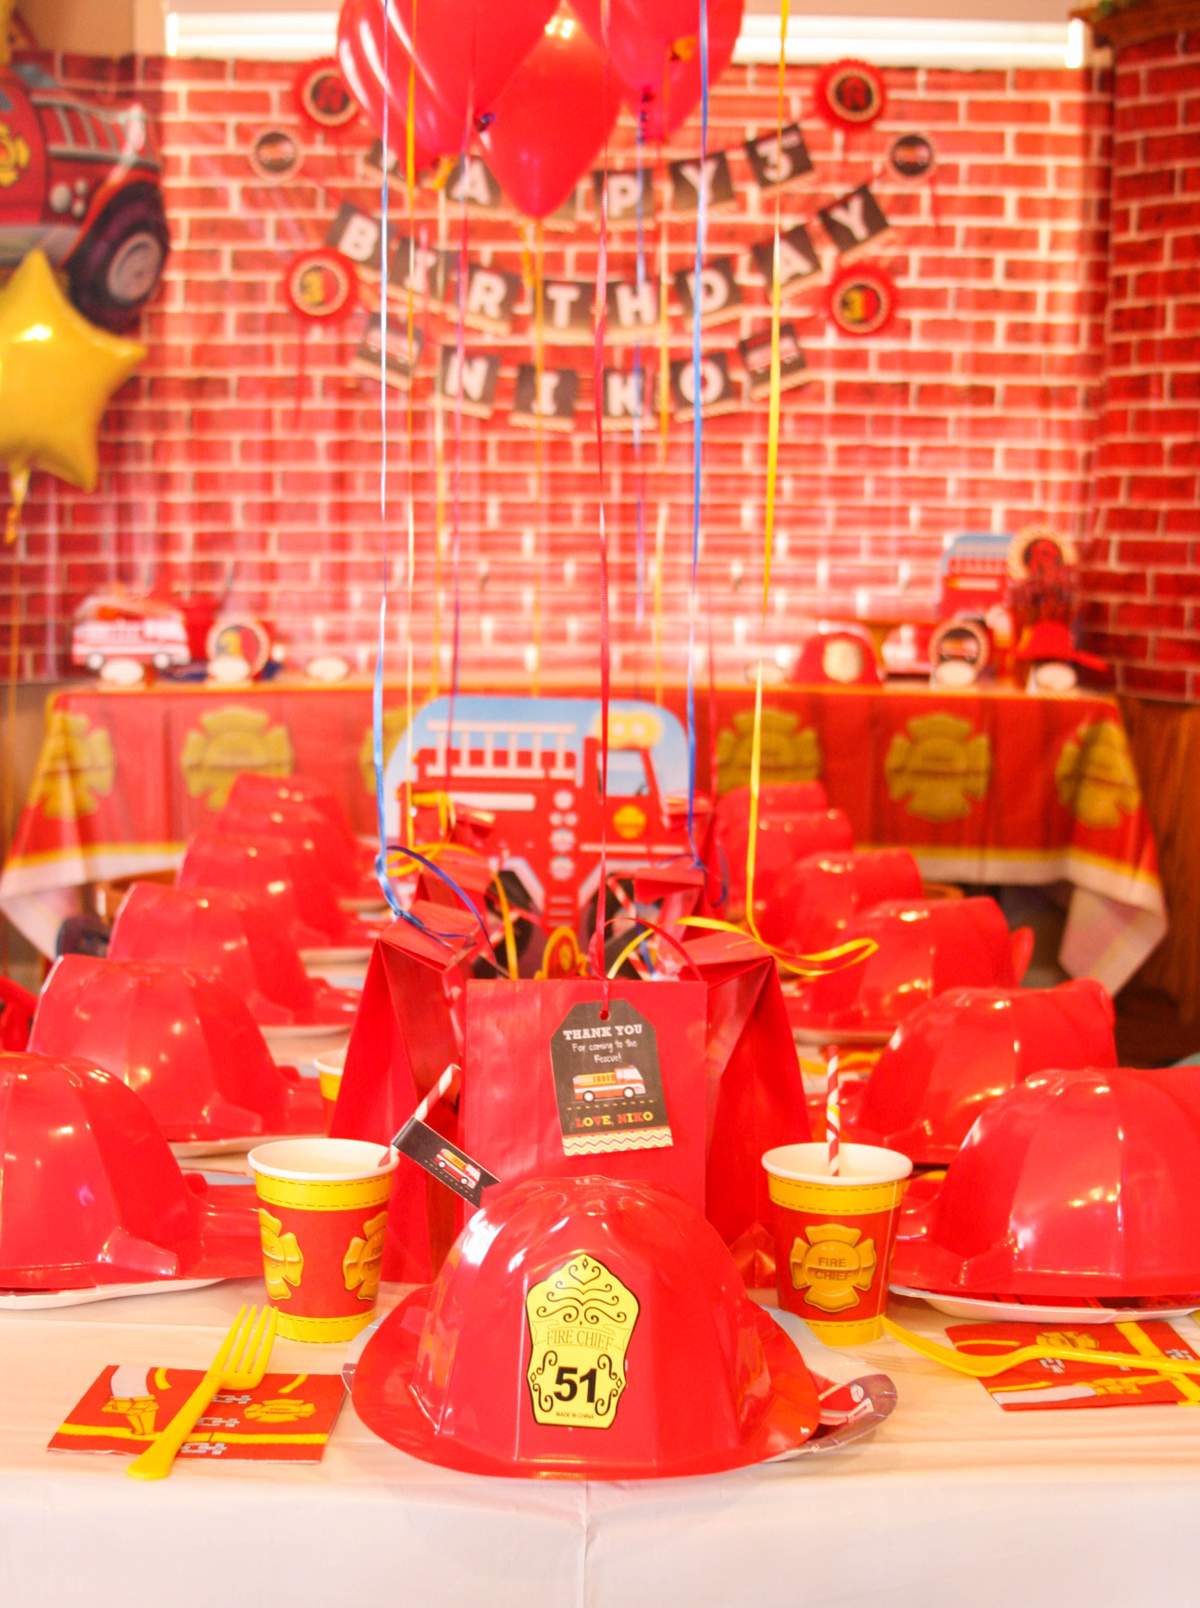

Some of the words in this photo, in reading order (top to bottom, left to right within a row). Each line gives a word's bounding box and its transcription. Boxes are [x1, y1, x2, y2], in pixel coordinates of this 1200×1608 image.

[338, 195, 869, 328] BIRTHDAY
[562, 1026, 613, 1041] THANK
[615, 1024, 643, 1037] YOU
[572, 1043, 586, 1052] For
[589, 1042, 614, 1053] coming
[614, 1040, 623, 1049] to
[625, 1039, 638, 1048] the
[575, 1115, 614, 1128] LOVE,
[617, 1111, 654, 1124] NIKO
[817, 1256, 848, 1268] FIRE
[815, 1270, 850, 1281] CHIEF
[546, 1329, 574, 1346] FIRE
[576, 1330, 615, 1351] CHIEF
[553, 1366, 598, 1403] 51
